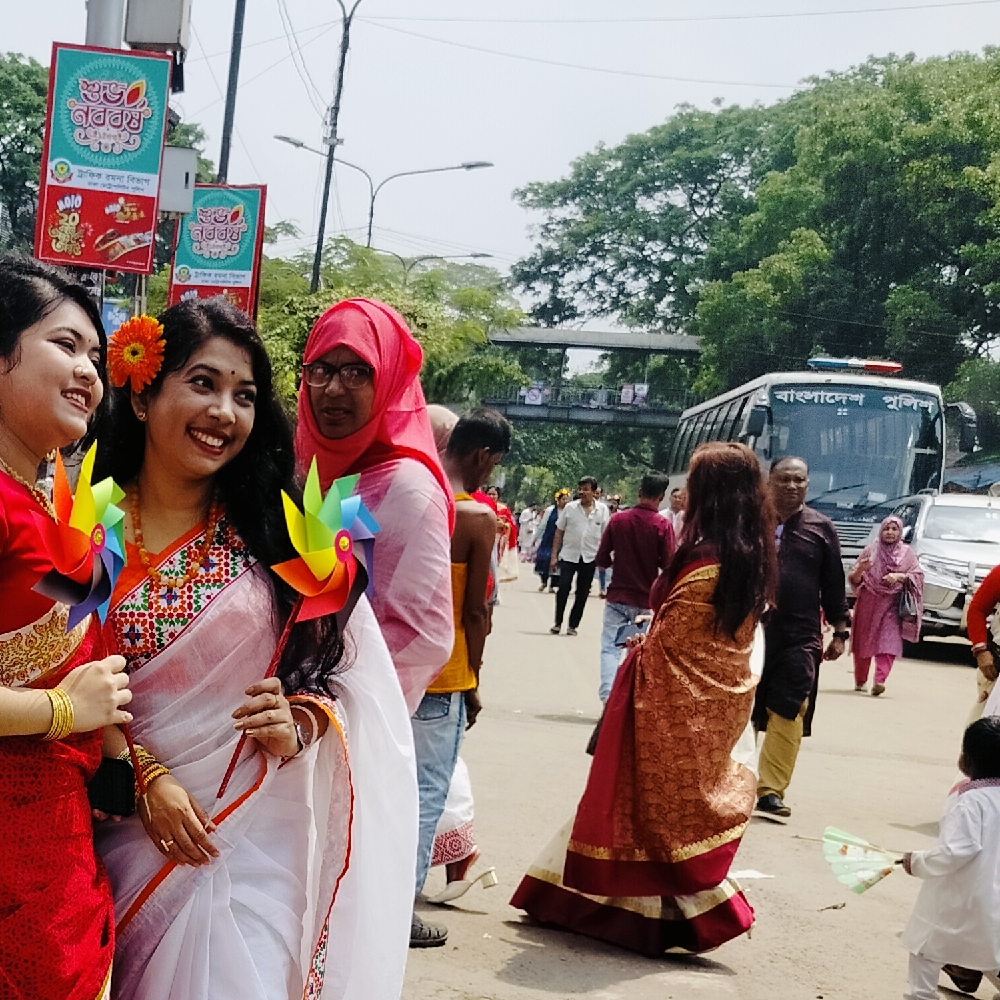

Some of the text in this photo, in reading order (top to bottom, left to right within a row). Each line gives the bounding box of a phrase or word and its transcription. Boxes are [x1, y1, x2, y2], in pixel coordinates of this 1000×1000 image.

[79, 79, 127, 105] শুভ
[70, 99, 148, 133] নববর্ষ
[77, 169, 151, 186] ট্রাফিক রমনা বিভাগ
[57, 194, 82, 211] MOJO
[57, 212, 79, 226] 20
[197, 207, 232, 224] শুভ
[190, 217, 245, 243] নববর্ষ
[774, 389, 935, 414] বাংলাদেশ পুলিশ
